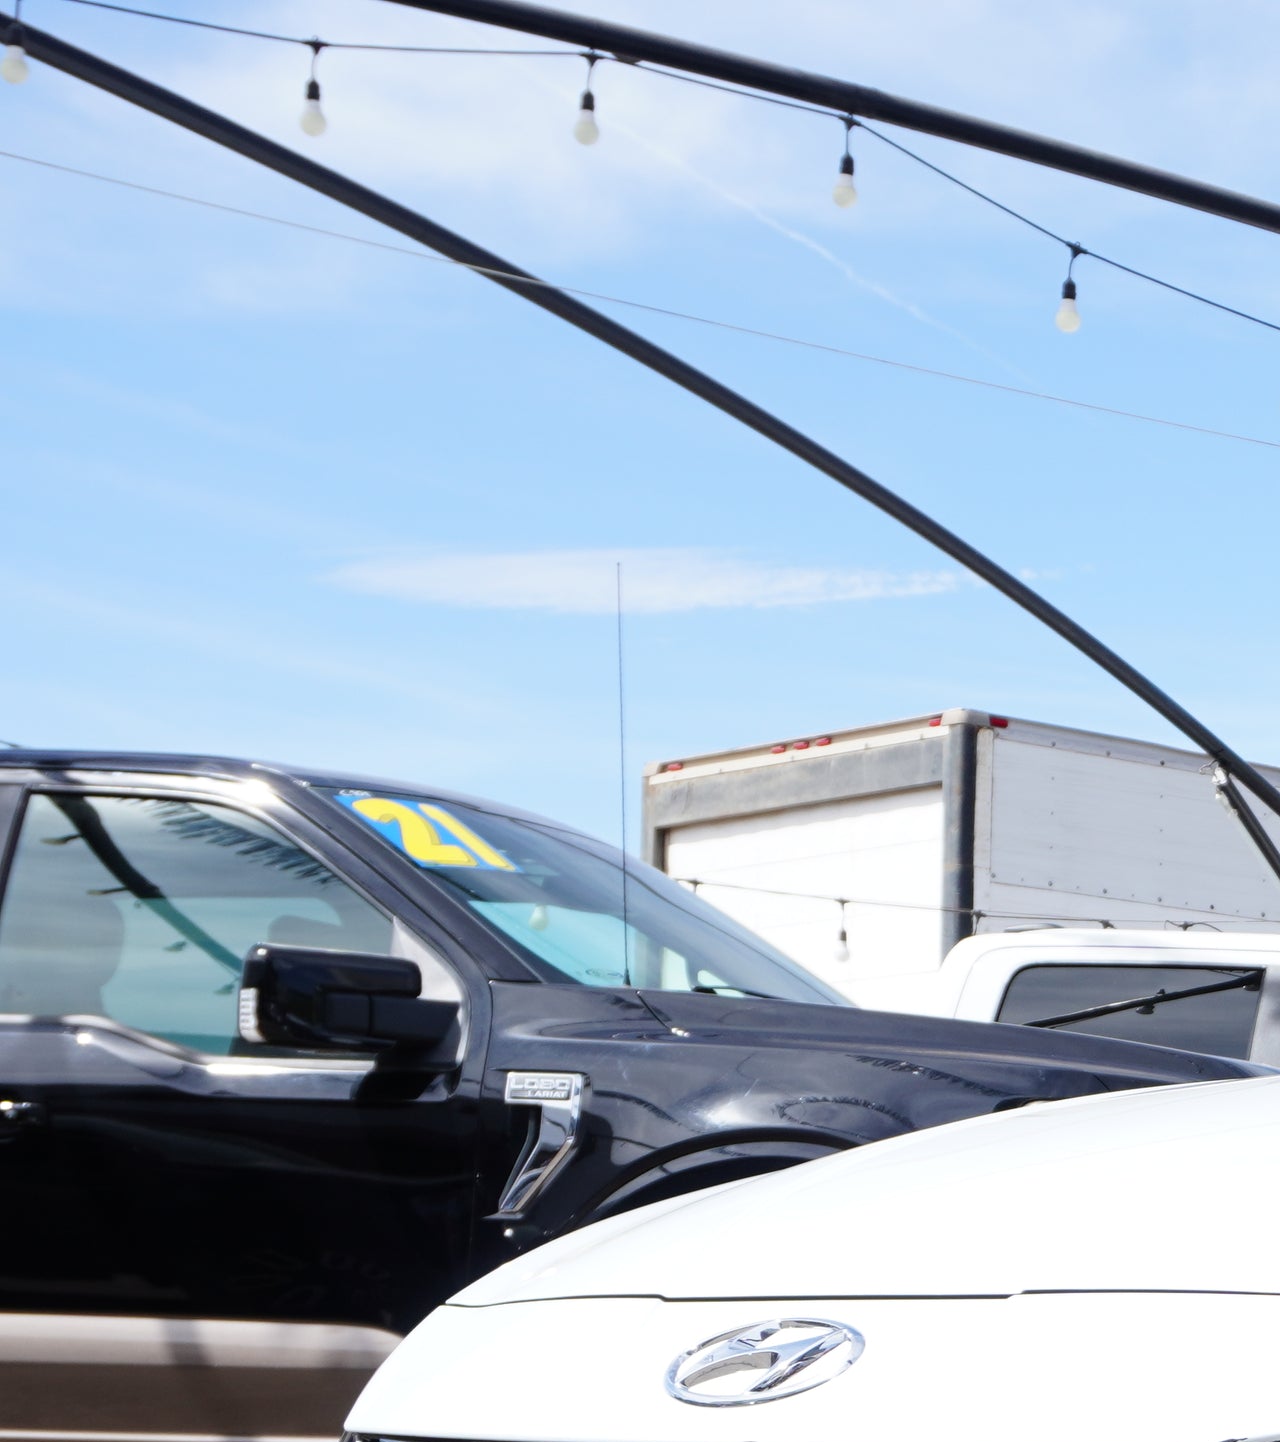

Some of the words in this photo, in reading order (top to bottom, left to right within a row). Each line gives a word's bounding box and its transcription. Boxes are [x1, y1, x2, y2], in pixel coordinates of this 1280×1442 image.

[352, 797, 516, 872] 21
[510, 1077, 571, 1090] LOBO
[527, 1089, 568, 1099] LARIAT
